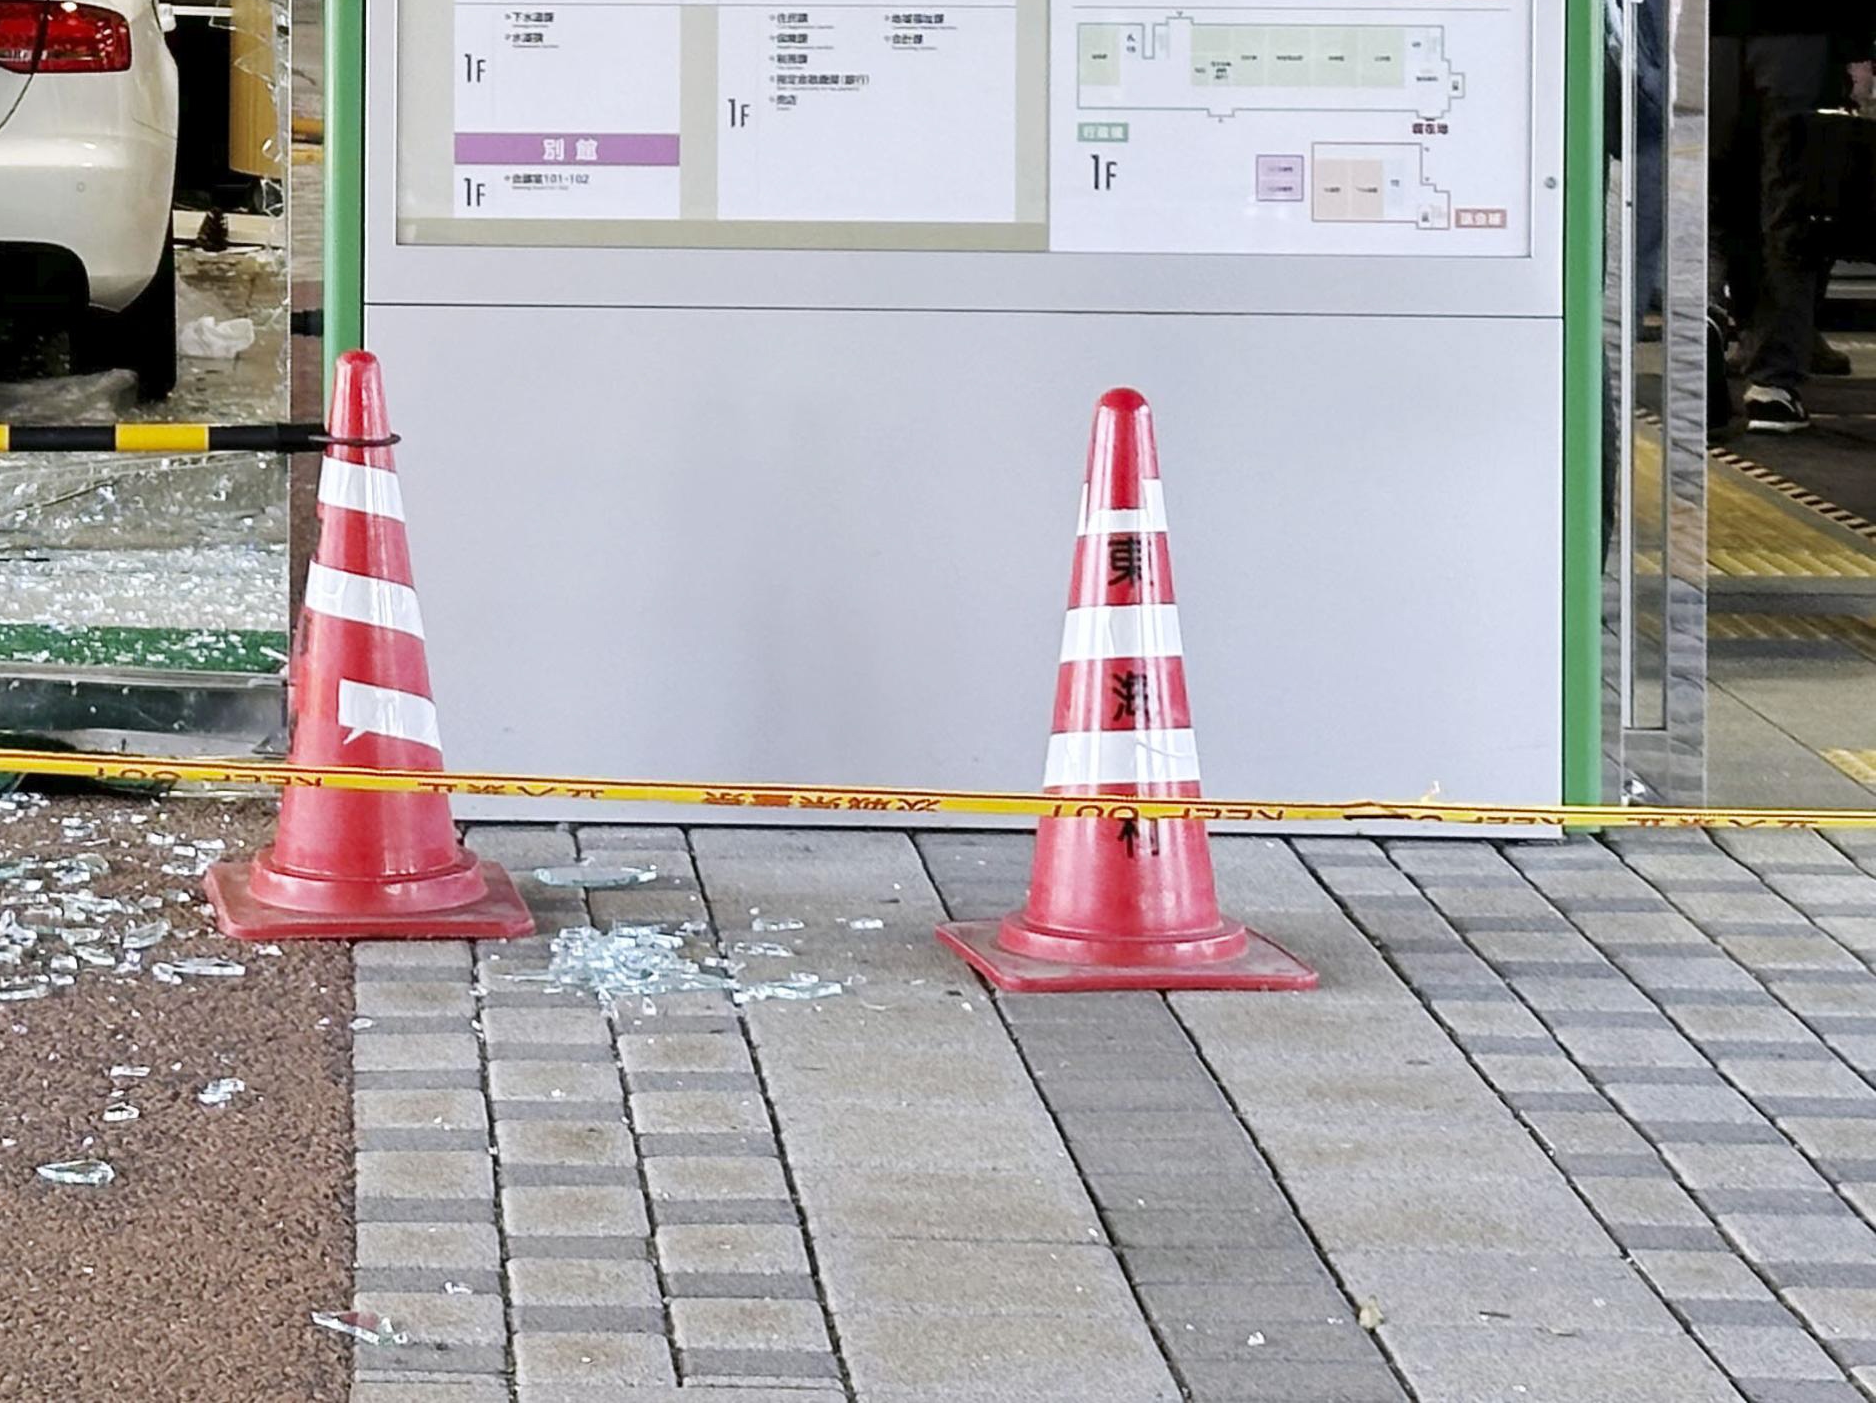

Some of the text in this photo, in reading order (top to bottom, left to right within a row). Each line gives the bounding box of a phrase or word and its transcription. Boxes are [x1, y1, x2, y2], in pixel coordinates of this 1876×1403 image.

[465, 53, 486, 83] 1F
[728, 98, 750, 128] 1F
[543, 139, 598, 161] 別館
[1091, 154, 1118, 190] 1F
[464, 178, 486, 207] 1F
